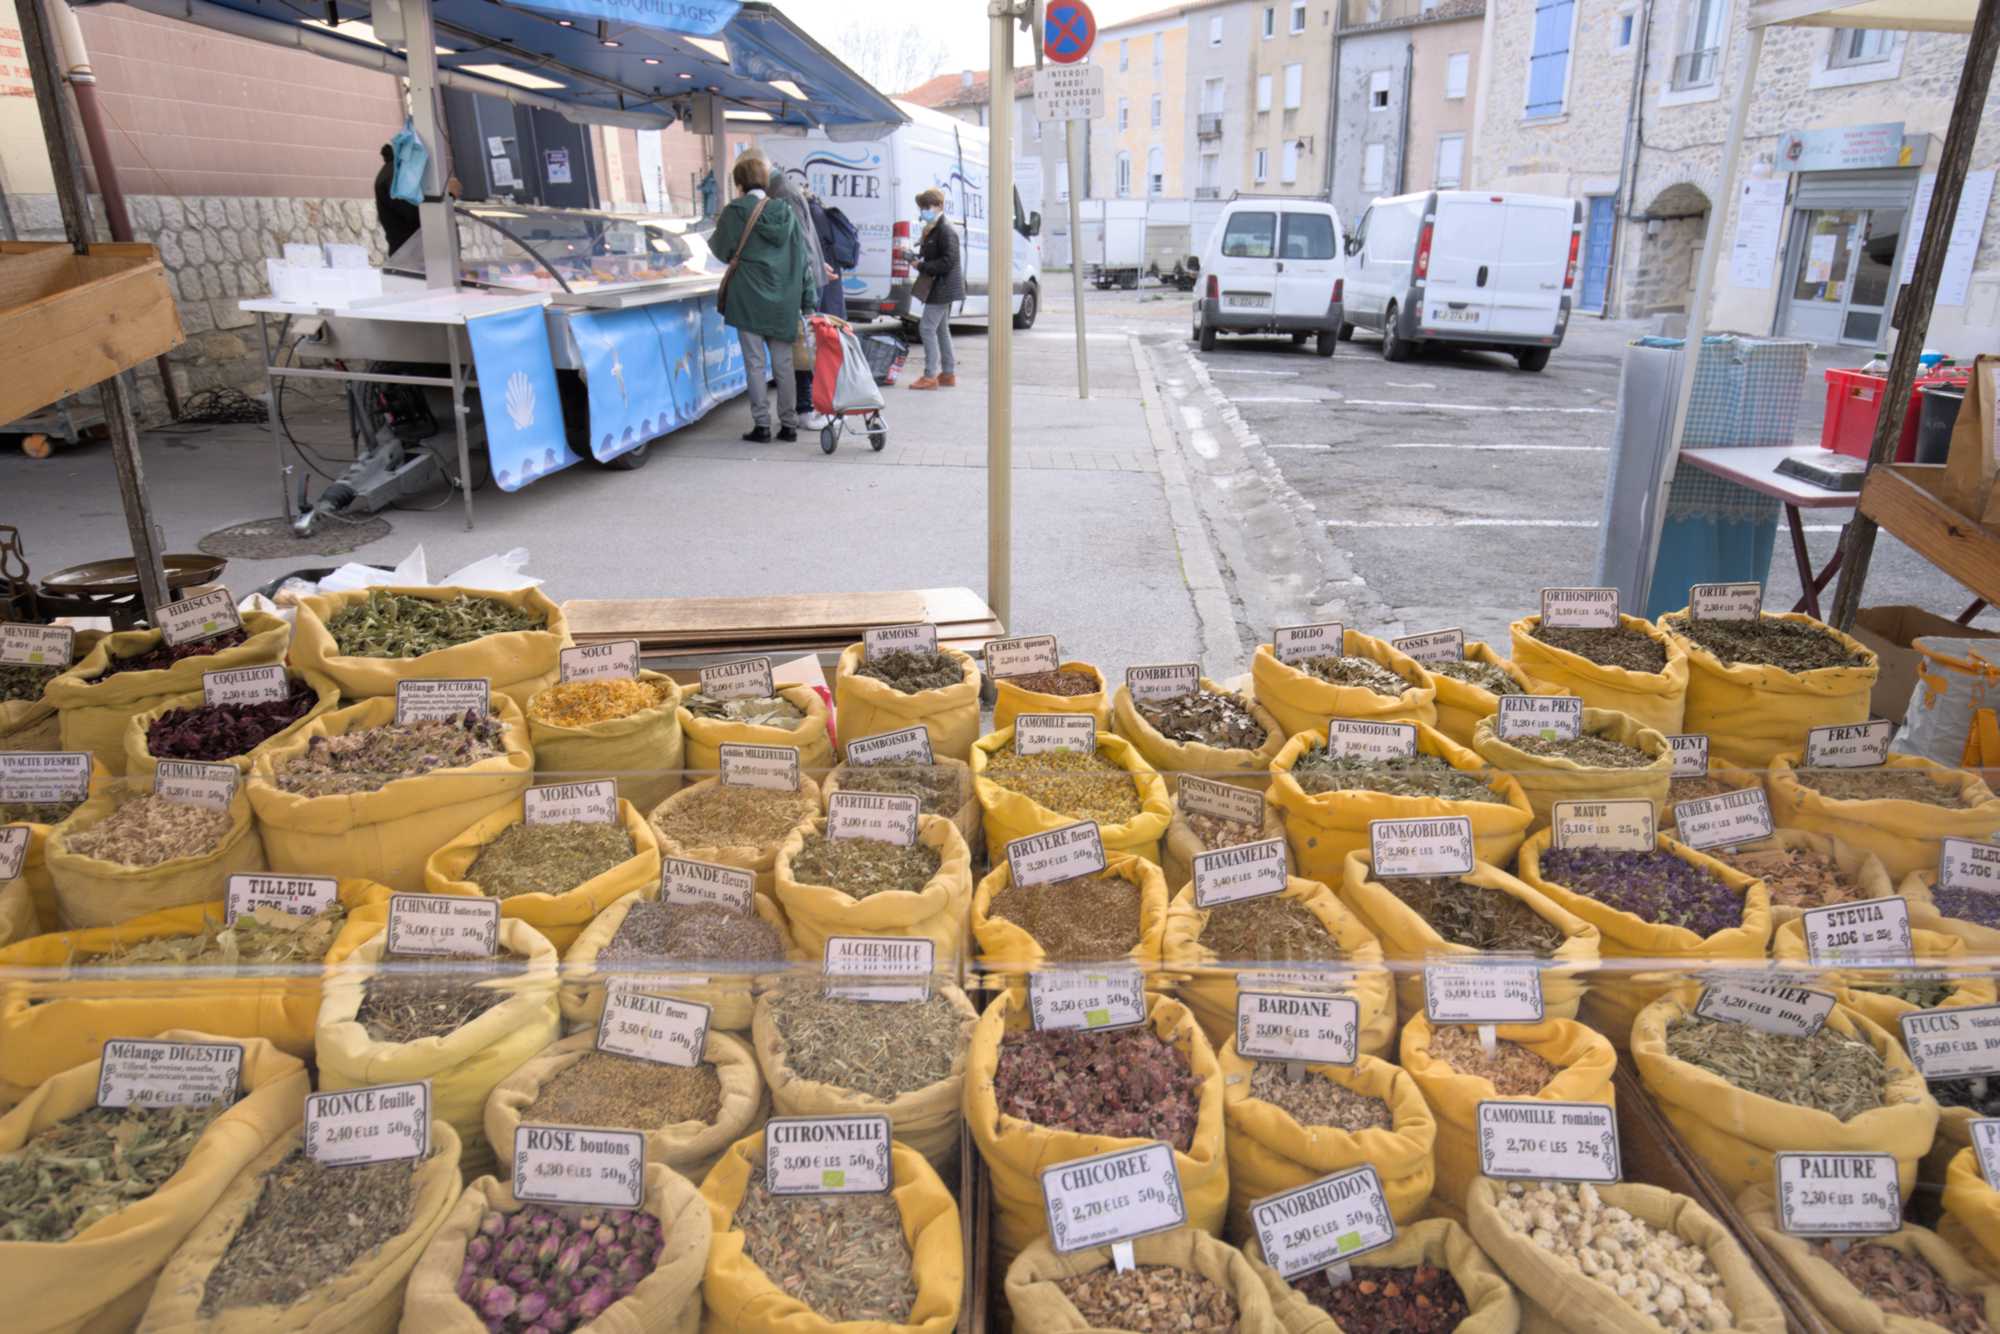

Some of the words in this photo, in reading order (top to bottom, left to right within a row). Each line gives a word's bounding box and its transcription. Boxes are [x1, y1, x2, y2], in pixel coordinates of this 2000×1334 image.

[1048, 69, 1088, 78] INTERDIT
[1055, 88, 1101, 97] VENDREDI
[830, 173, 880, 198] MER
[1547, 590, 1614, 602] ORTHOSIPHON
[1699, 587, 1728, 597] ORTIE
[169, 594, 222, 617] HIBISCUS
[4, 627, 40, 637] MENTHE
[876, 629, 920, 640] ARMOISE
[1291, 628, 1323, 640] BOLDO
[581, 647, 612, 658] SOUCI
[990, 642, 1020, 651] CERISE
[1397, 639, 1429, 651] CASSIS
[213, 669, 274, 685] COQUELICOT
[705, 663, 764, 679] EUCALYPTUS
[1130, 668, 1195, 680] COMBRETUM
[437, 683, 483, 691] PECTORAL
[1505, 700, 1536, 711] REINE
[1019, 717, 1065, 728] CAMOMILLE
[1338, 724, 1400, 736] DESMODIUM
[854, 732, 917, 754] FRAMBOISIER
[160, 764, 206, 777] GUIMAUVE
[539, 784, 601, 802] MORINGA
[835, 797, 885, 808] MYRTILLE
[1677, 802, 1712, 818] AUBIER
[1723, 792, 1762, 810] TILLEUL
[1574, 807, 1607, 817] MAUVE
[1736, 815, 1760, 824] 100g
[870, 819, 881, 827] LES
[887, 821, 906, 831] 50g
[1617, 825, 1639, 836] 25g
[1012, 832, 1069, 858] BRUYERE
[1071, 829, 1095, 841] fleurs
[1420, 847, 1433, 855] LES
[1440, 846, 1460, 856] 50g
[1073, 850, 1092, 860] 50g
[1204, 845, 1278, 871] HAMAMELIS
[666, 863, 719, 883] LAVANDE
[722, 874, 749, 889] fleurs
[1238, 874, 1251, 882] LES
[1257, 868, 1276, 878] 50g
[248, 880, 316, 896] TILLEUL
[1827, 906, 1883, 927] STEVIA
[441, 928, 454, 936] LES
[462, 928, 483, 941] 50g
[840, 943, 921, 959] ALCHEMILLE
[614, 995, 665, 1016] SUREAU
[666, 1008, 687, 1020] fleurs
[1050, 999, 1076, 1013] 3,50
[1085, 998, 1099, 1007] LES
[1107, 994, 1130, 1007] 50g
[1258, 998, 1332, 1018] BARDANE
[1756, 1003, 1772, 1014] LES
[1778, 1009, 1808, 1028] 100g
[1911, 1016, 1959, 1034] FUCUS
[649, 1028, 663, 1039] LES
[670, 1032, 691, 1049] 50g
[1294, 1029, 1309, 1039] LES
[1318, 1029, 1342, 1045] 50g
[111, 1045, 165, 1062] Mélange
[169, 1045, 236, 1063] DIGESTIF
[1952, 1042, 1960, 1052] €
[1961, 1042, 1978, 1051] LES
[317, 1092, 376, 1118] RONCE
[380, 1092, 416, 1110] feuille
[1483, 1108, 1555, 1125] CAMOMILLE
[1562, 1113, 1607, 1127] romaine
[326, 1127, 352, 1144] 2,40
[354, 1128, 362, 1138] €
[364, 1127, 379, 1137] LES
[387, 1123, 411, 1137] 50g
[774, 1124, 882, 1144] CITRONNELLE
[527, 1131, 575, 1151] ROSE
[580, 1135, 630, 1155] boutons
[1507, 1139, 1536, 1153] 2,70
[1539, 1140, 1547, 1151] €
[1550, 1142, 1567, 1153] LES
[1577, 1142, 1600, 1158] 25g
[814, 1156, 821, 1166] €
[824, 1155, 840, 1166] LES
[849, 1155, 874, 1169] 50g
[1800, 1159, 1877, 1179] PALIURE
[567, 1165, 574, 1176] €
[575, 1167, 591, 1177] LES
[600, 1165, 626, 1184] 50g
[1061, 1154, 1151, 1191] CHICOREE
[1073, 1203, 1103, 1220] 2,70
[1104, 1200, 1112, 1212] €
[1113, 1198, 1130, 1210] LES
[1138, 1189, 1166, 1203] 50g
[1259, 1175, 1373, 1227] CYNORRHODON
[1829, 1193, 1835, 1204] €
[1838, 1194, 1853, 1205] LES
[1862, 1193, 1886, 1210] 50g
[1283, 1228, 1311, 1248] 2,90
[1313, 1226, 1321, 1237] €
[1322, 1221, 1339, 1234] LES
[1347, 1210, 1374, 1226] 50g
